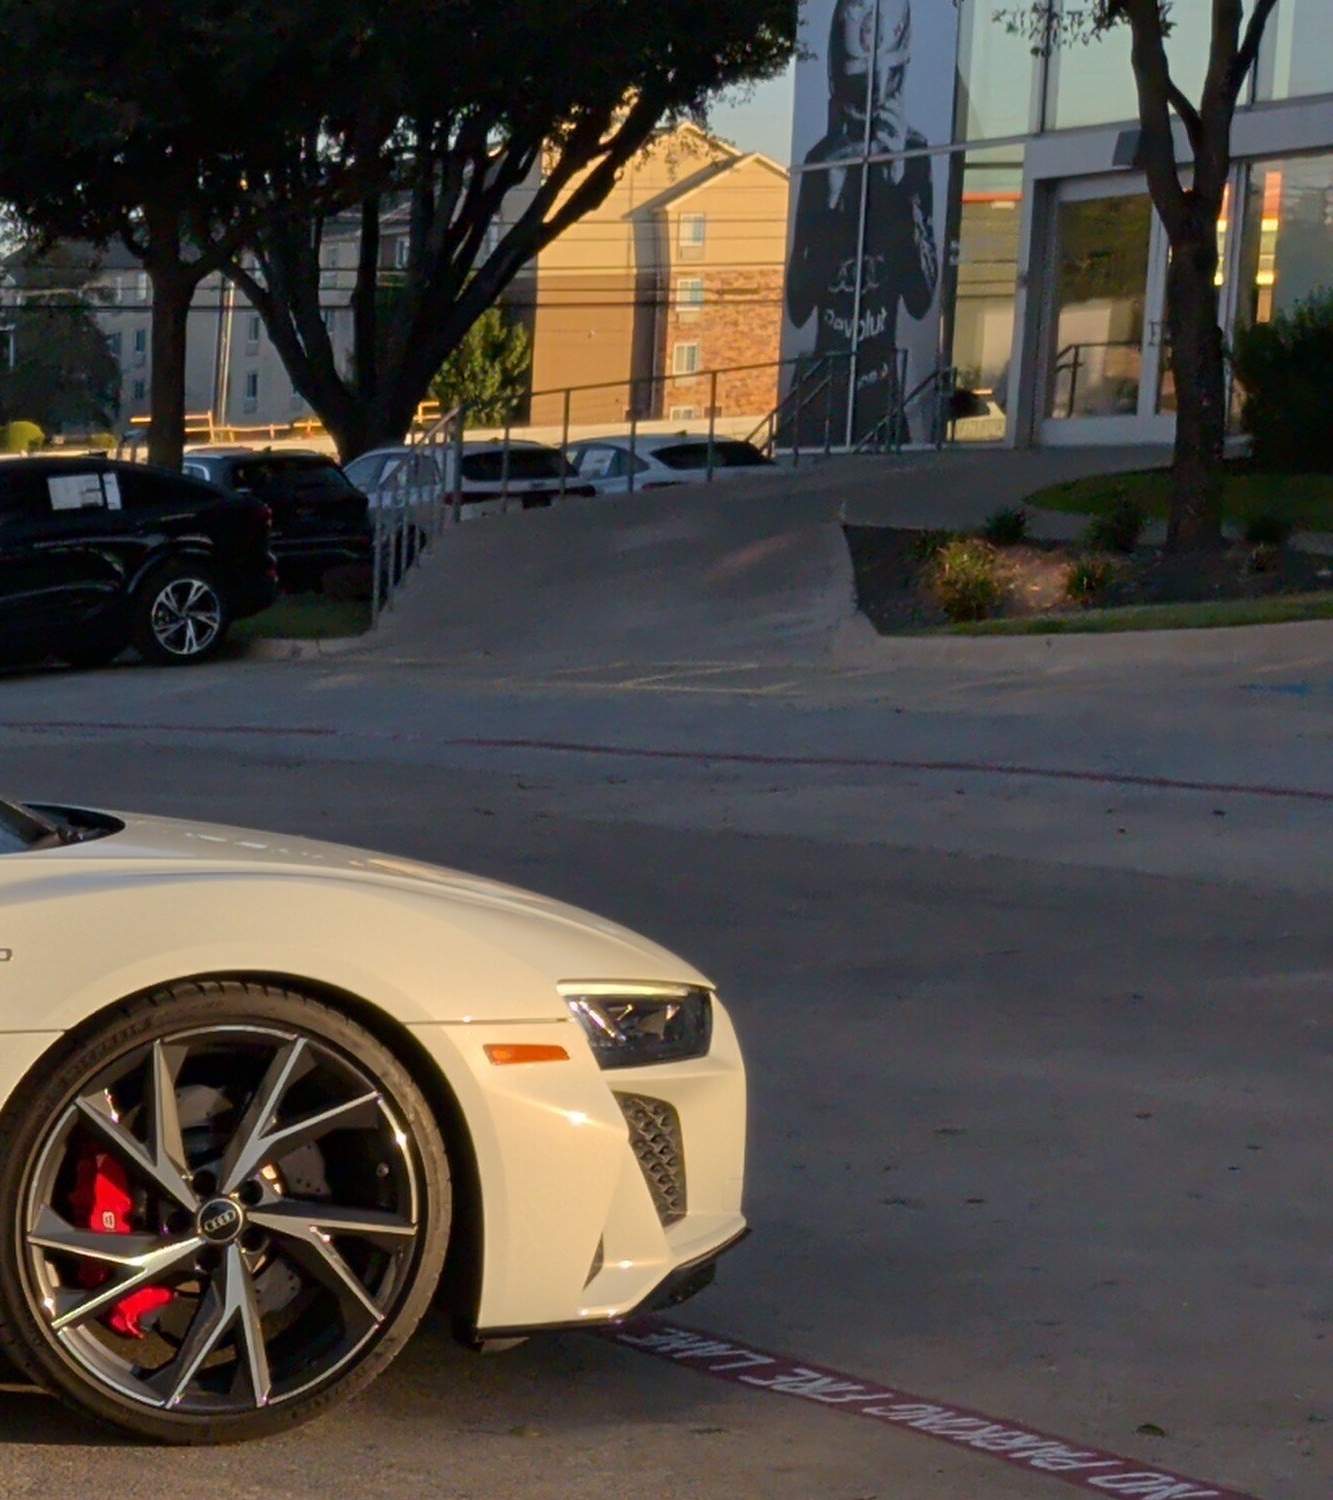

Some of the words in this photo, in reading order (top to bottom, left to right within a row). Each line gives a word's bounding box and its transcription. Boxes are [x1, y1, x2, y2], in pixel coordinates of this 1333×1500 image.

[617, 1327, 776, 1371] LANE
[738, 1367, 895, 1403] FIRE
[862, 1404, 1123, 1471] PARKING
[1087, 1472, 1220, 1500] NO
